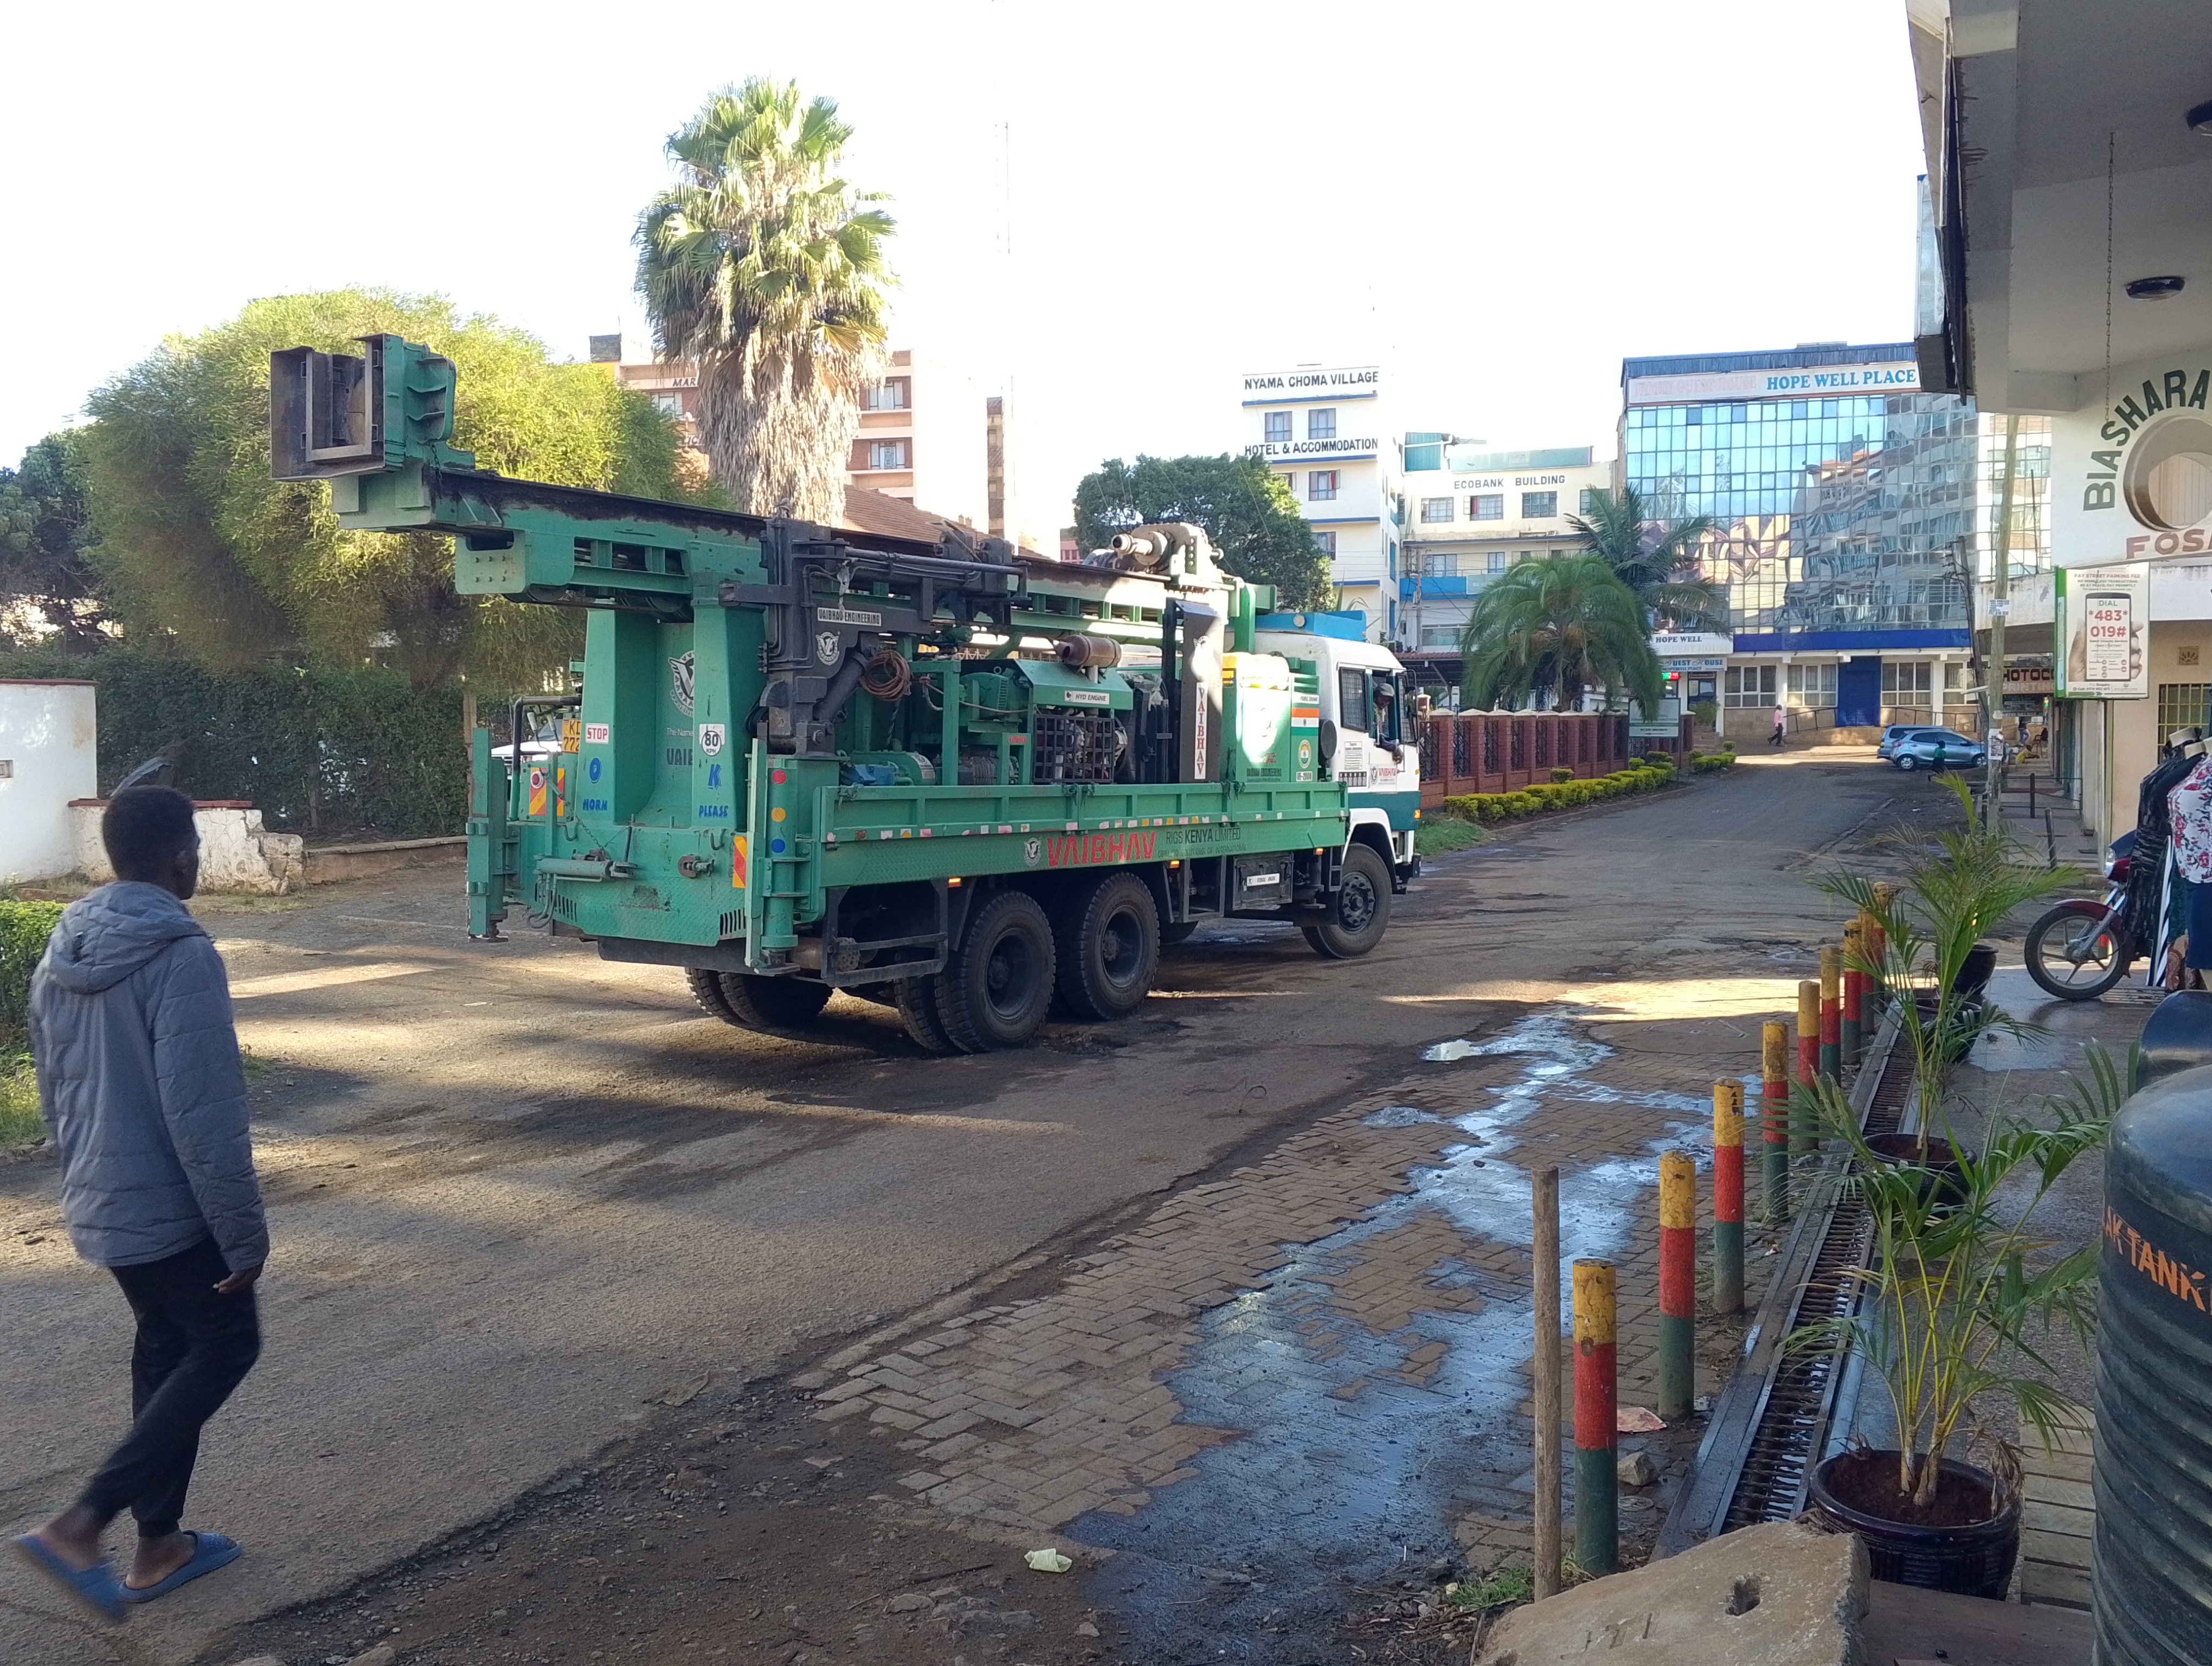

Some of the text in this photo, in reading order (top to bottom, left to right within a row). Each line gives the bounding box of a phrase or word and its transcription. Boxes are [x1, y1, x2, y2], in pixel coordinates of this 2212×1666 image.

[672, 378, 699, 387] MAR
[1245, 371, 1379, 389] NYAMA CHOMA VILLAGE
[1767, 369, 1917, 390] HOPE WELL PLACE
[1245, 438, 1378, 456] HOTEL & ACCOMMODATION
[2084, 369, 2210, 511] BIASHARA
[1454, 475, 1566, 489] ECOBANK BUILDING
[2126, 528, 2212, 560] FOS
[844, 611, 880, 625] ENGINEERING
[2090, 625, 2126, 637] 019#
[1692, 657, 1724, 667] HOUSE
[2003, 668, 2055, 682] HOTOC
[587, 727, 608, 740] STOP
[666, 727, 677, 736] The
[705, 733, 719, 747] 80
[1196, 687, 1206, 776] VAIBHAV
[708, 764, 722, 790] K
[582, 798, 729, 818] HORN PLEASE
[1047, 831, 1156, 867] VAIBHAV
[1166, 831, 1183, 844] RIGS
[1185, 828, 1213, 844] KENYA
[1214, 828, 1241, 841] LIMITED
[2127, 1227, 2206, 1312] TANK
